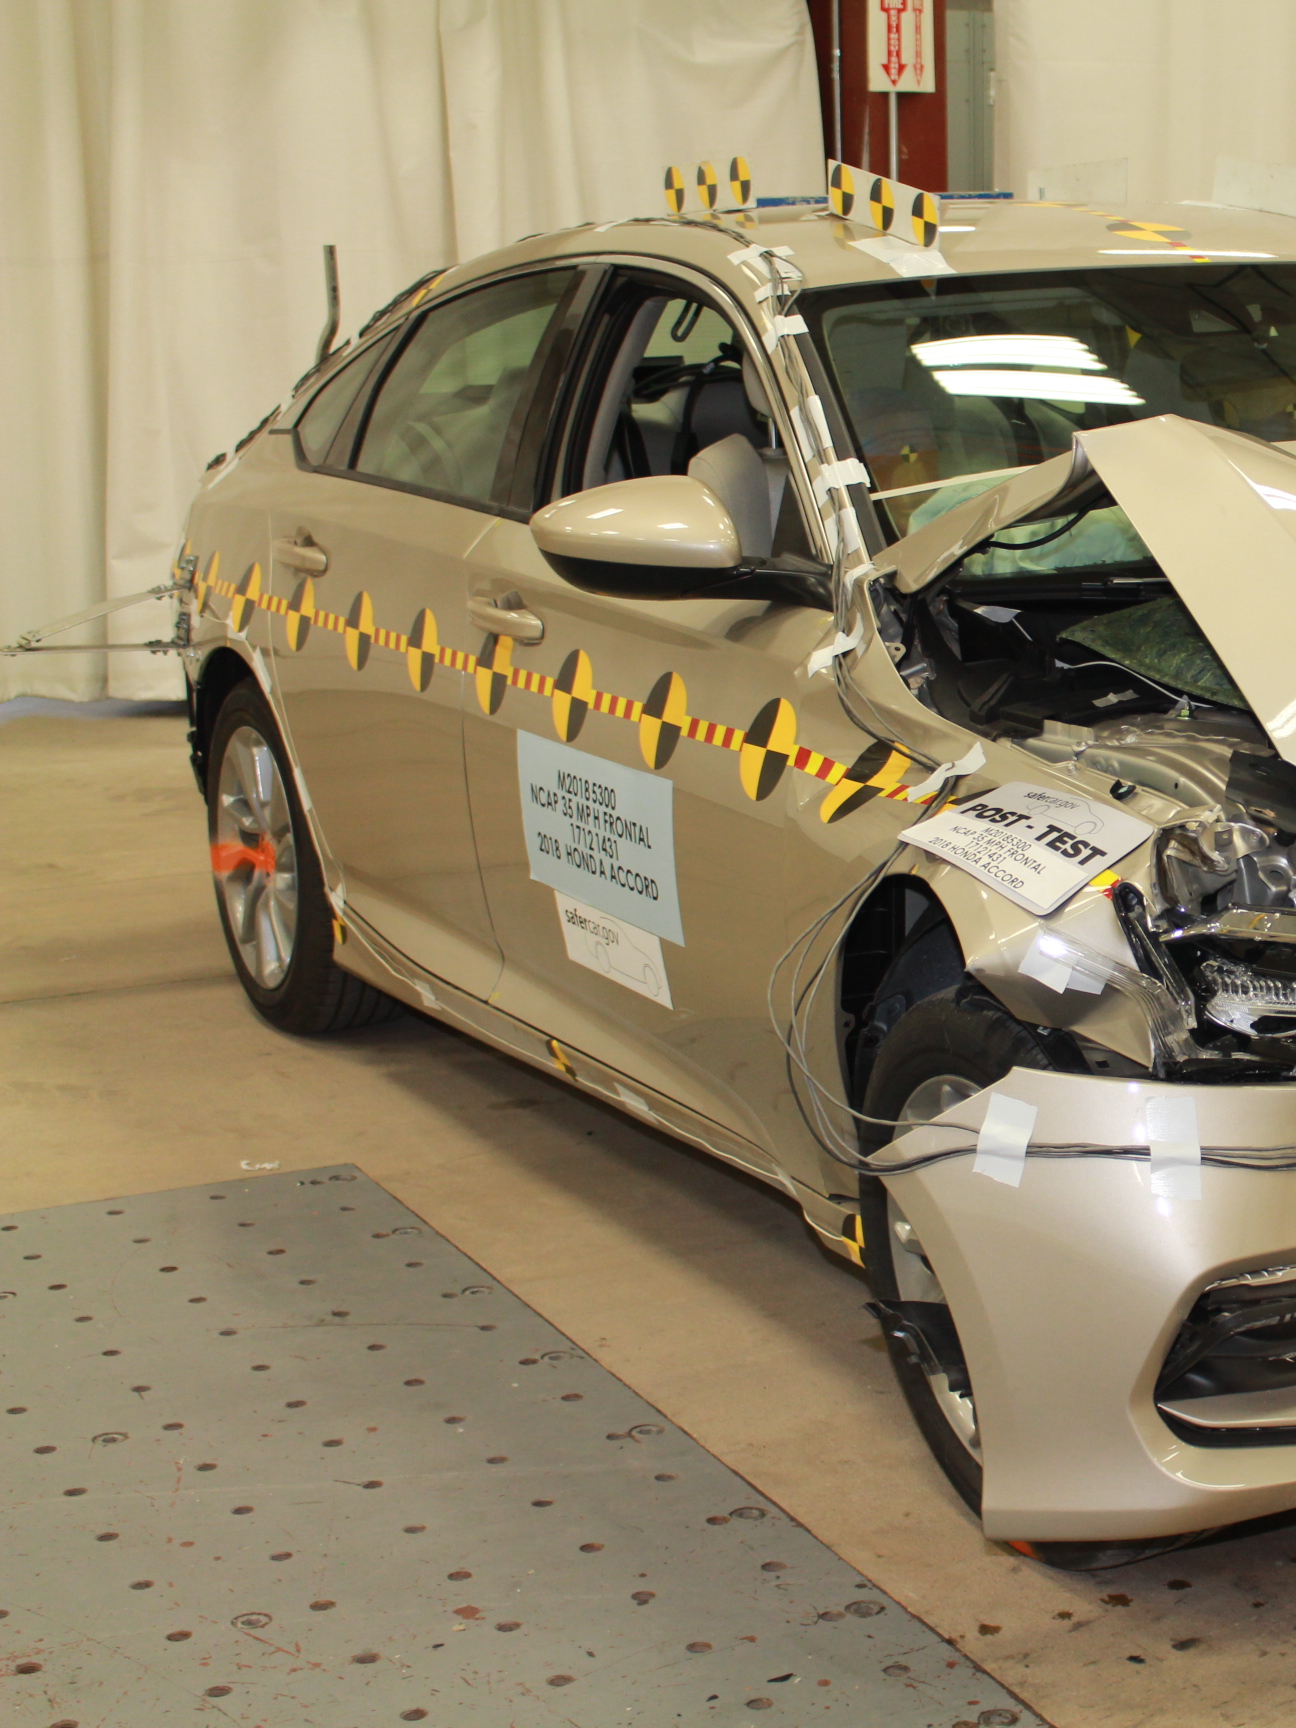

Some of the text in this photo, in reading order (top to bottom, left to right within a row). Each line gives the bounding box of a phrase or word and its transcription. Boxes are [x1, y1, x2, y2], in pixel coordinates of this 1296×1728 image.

[530, 782, 652, 850] NCAP 35 MPH FRONTAL
[1023, 791, 1081, 810] safercar.gov
[570, 822, 619, 861] 17121431
[949, 825, 1047, 875] NCAP 35 MPH FRONTAL
[959, 803, 1033, 828] POST
[1034, 823, 1109, 867] TEST
[964, 840, 1007, 865] 17121431
[981, 826, 1033, 852] M20185300
[537, 831, 659, 901] 2018 HONDA ACCORD
[927, 836, 1025, 890] 2018 HONDA ACCORD
[565, 907, 619, 946] safercar.gov
